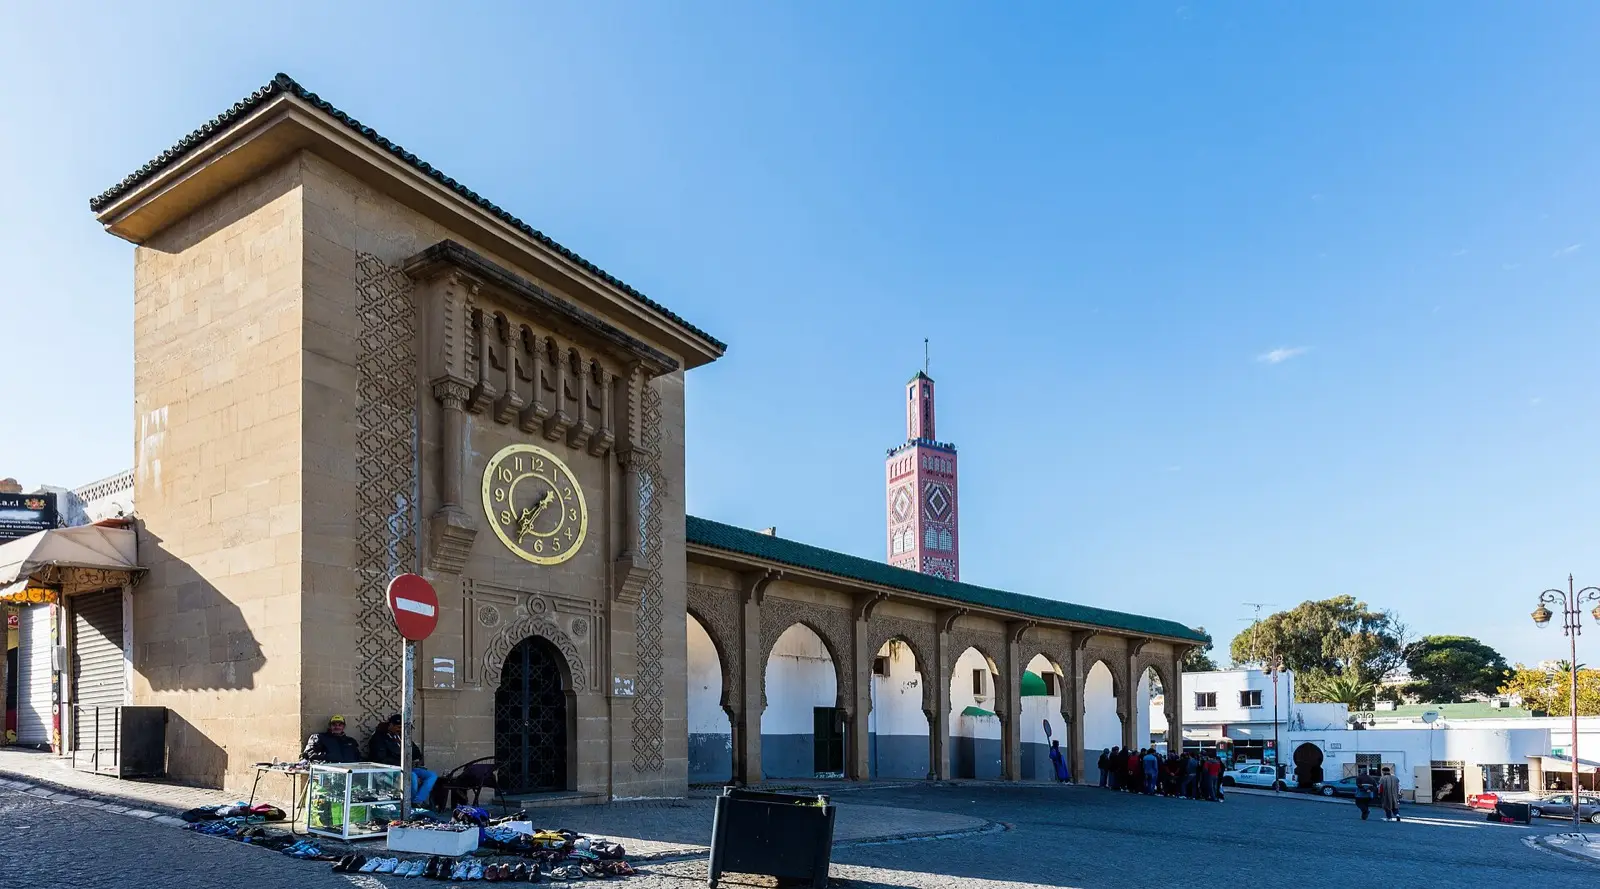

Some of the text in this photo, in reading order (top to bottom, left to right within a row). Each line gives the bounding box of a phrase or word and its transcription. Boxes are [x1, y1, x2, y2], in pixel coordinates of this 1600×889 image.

[515, 456, 523, 472] 11
[531, 456, 544, 472] 12
[497, 465, 513, 483] 10
[494, 488, 505, 502] 9
[564, 487, 572, 500] 2
[501, 510, 511, 525] 8
[568, 508, 577, 521] 3
[564, 527, 573, 540] 4
[533, 539, 543, 552] 6
[552, 538, 561, 551] 5
